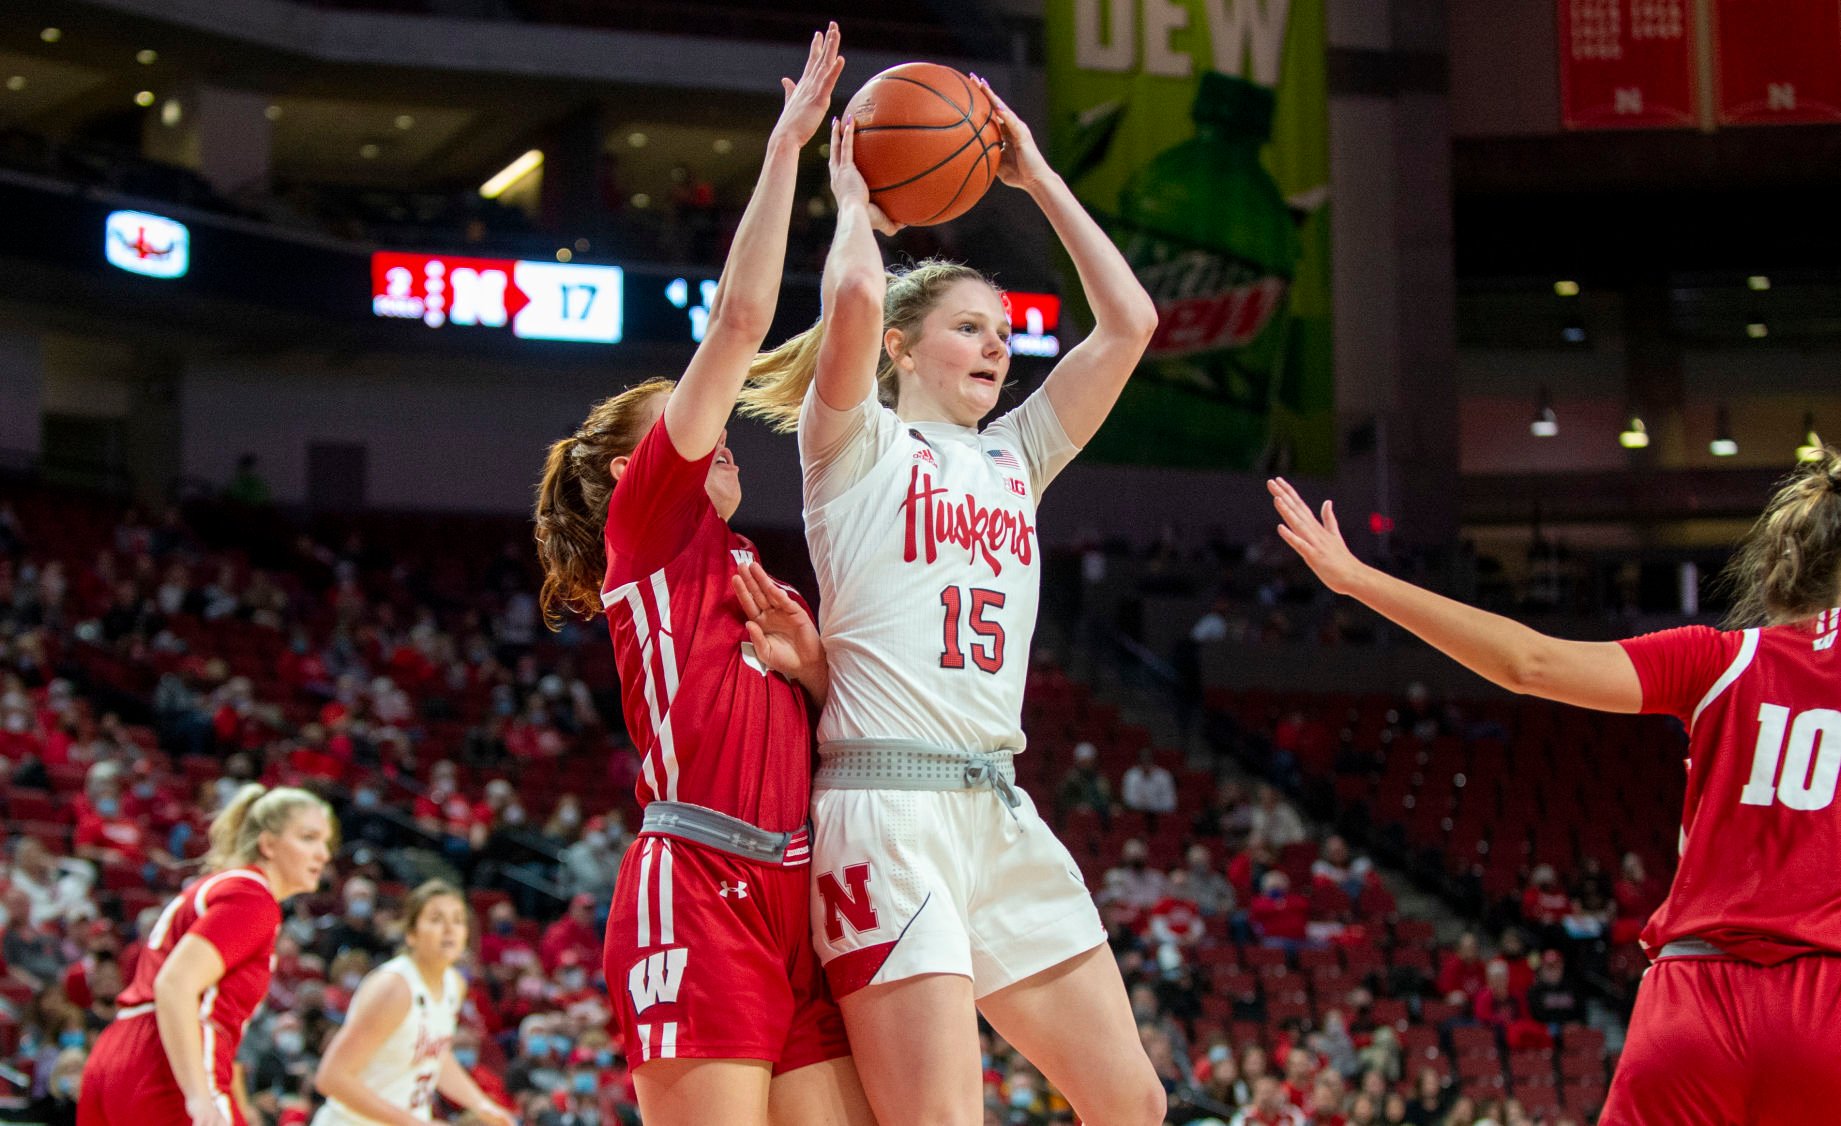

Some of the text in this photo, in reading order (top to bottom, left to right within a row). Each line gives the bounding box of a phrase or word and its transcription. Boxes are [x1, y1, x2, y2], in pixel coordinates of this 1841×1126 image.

[1074, 0, 1291, 88] DEW
[561, 283, 597, 321] 17
[897, 464, 1034, 577] Huskers
[939, 584, 1006, 675] 15
[1738, 702, 1841, 811] 10
[816, 861, 880, 943] N
[627, 947, 689, 1017] W
